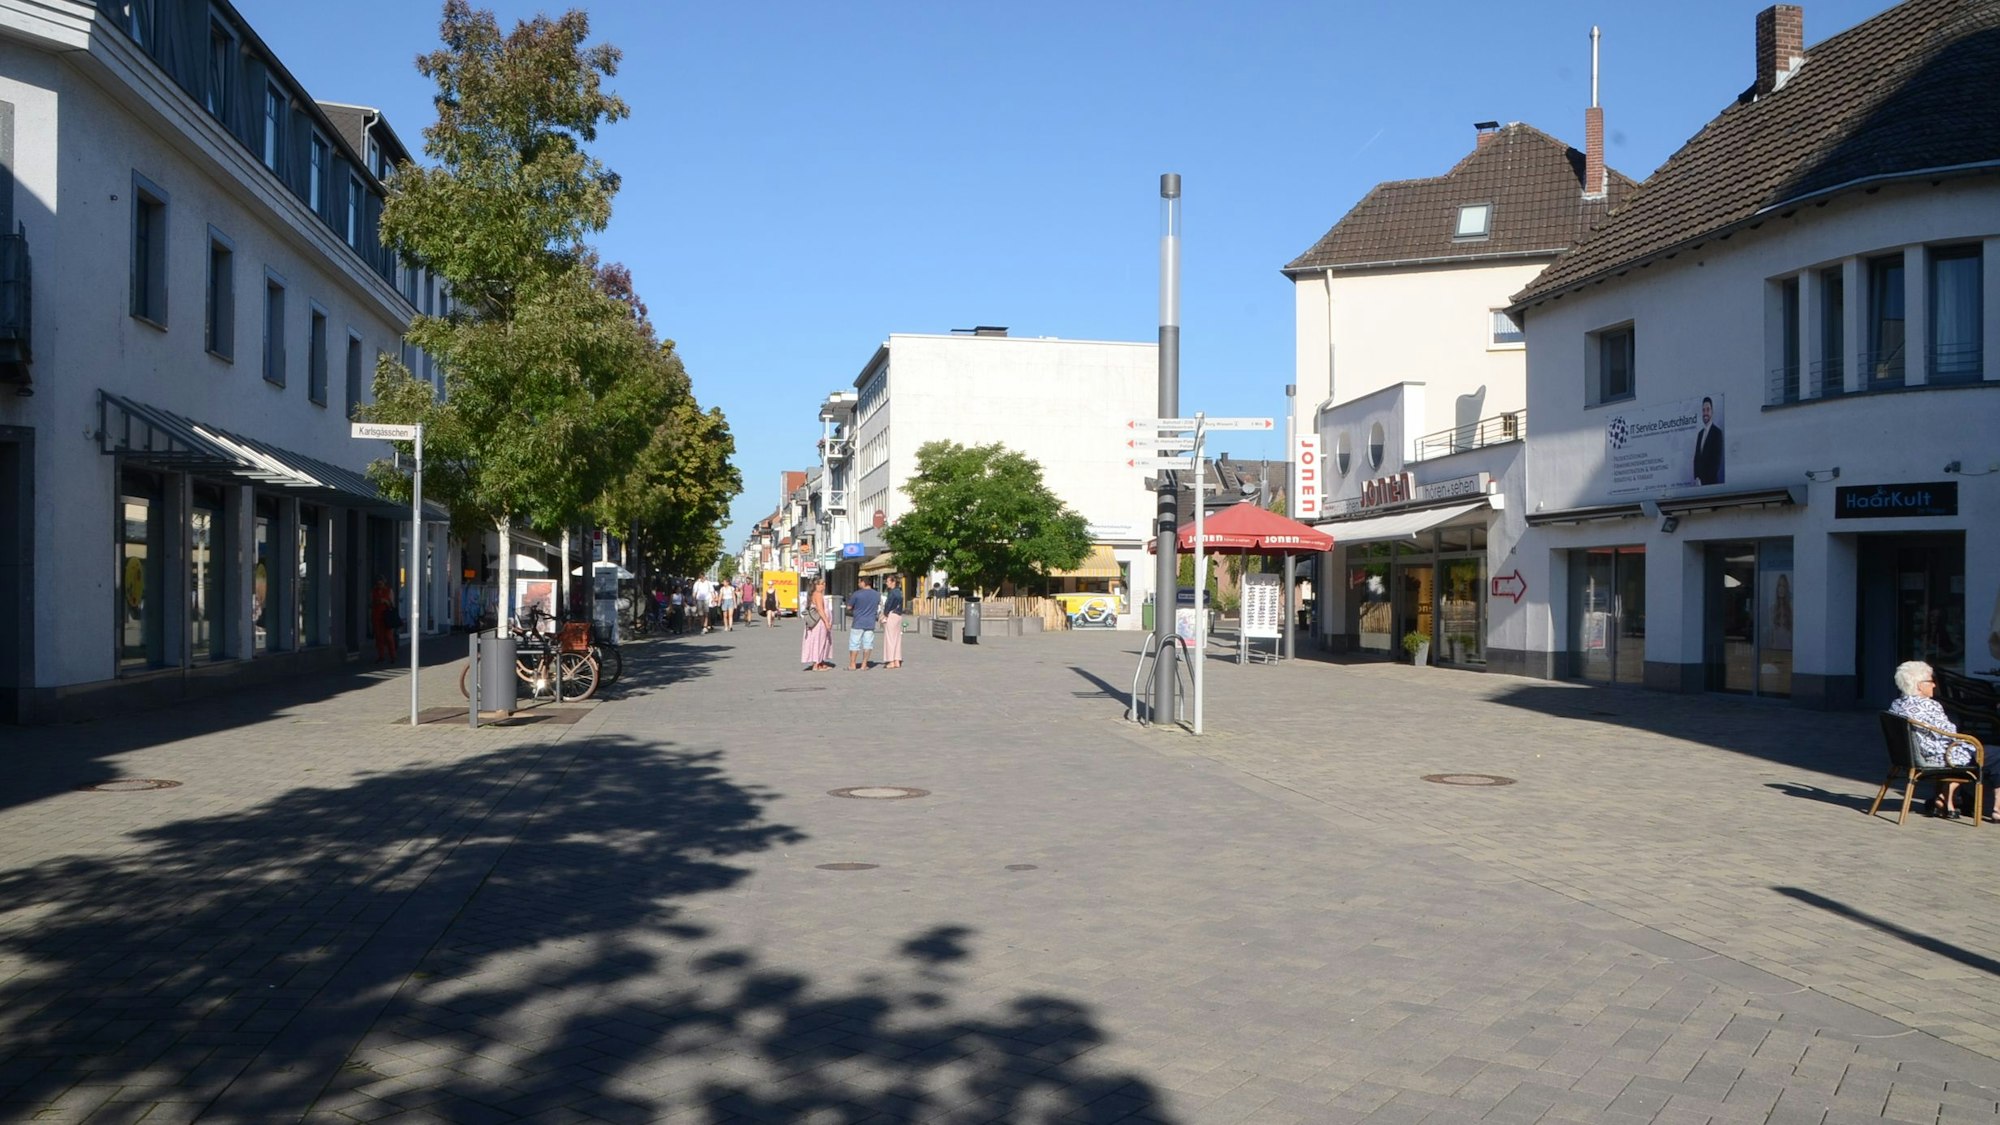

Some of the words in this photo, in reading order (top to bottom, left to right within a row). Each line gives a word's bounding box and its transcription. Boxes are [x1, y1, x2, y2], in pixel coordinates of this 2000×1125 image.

[359, 426, 408, 437] Karlsgässchen
[1630, 425, 1635, 434] IT
[1636, 422, 1657, 433] Service
[1659, 414, 1697, 430] Deutschland
[1846, 491, 1931, 508] HaarKult
